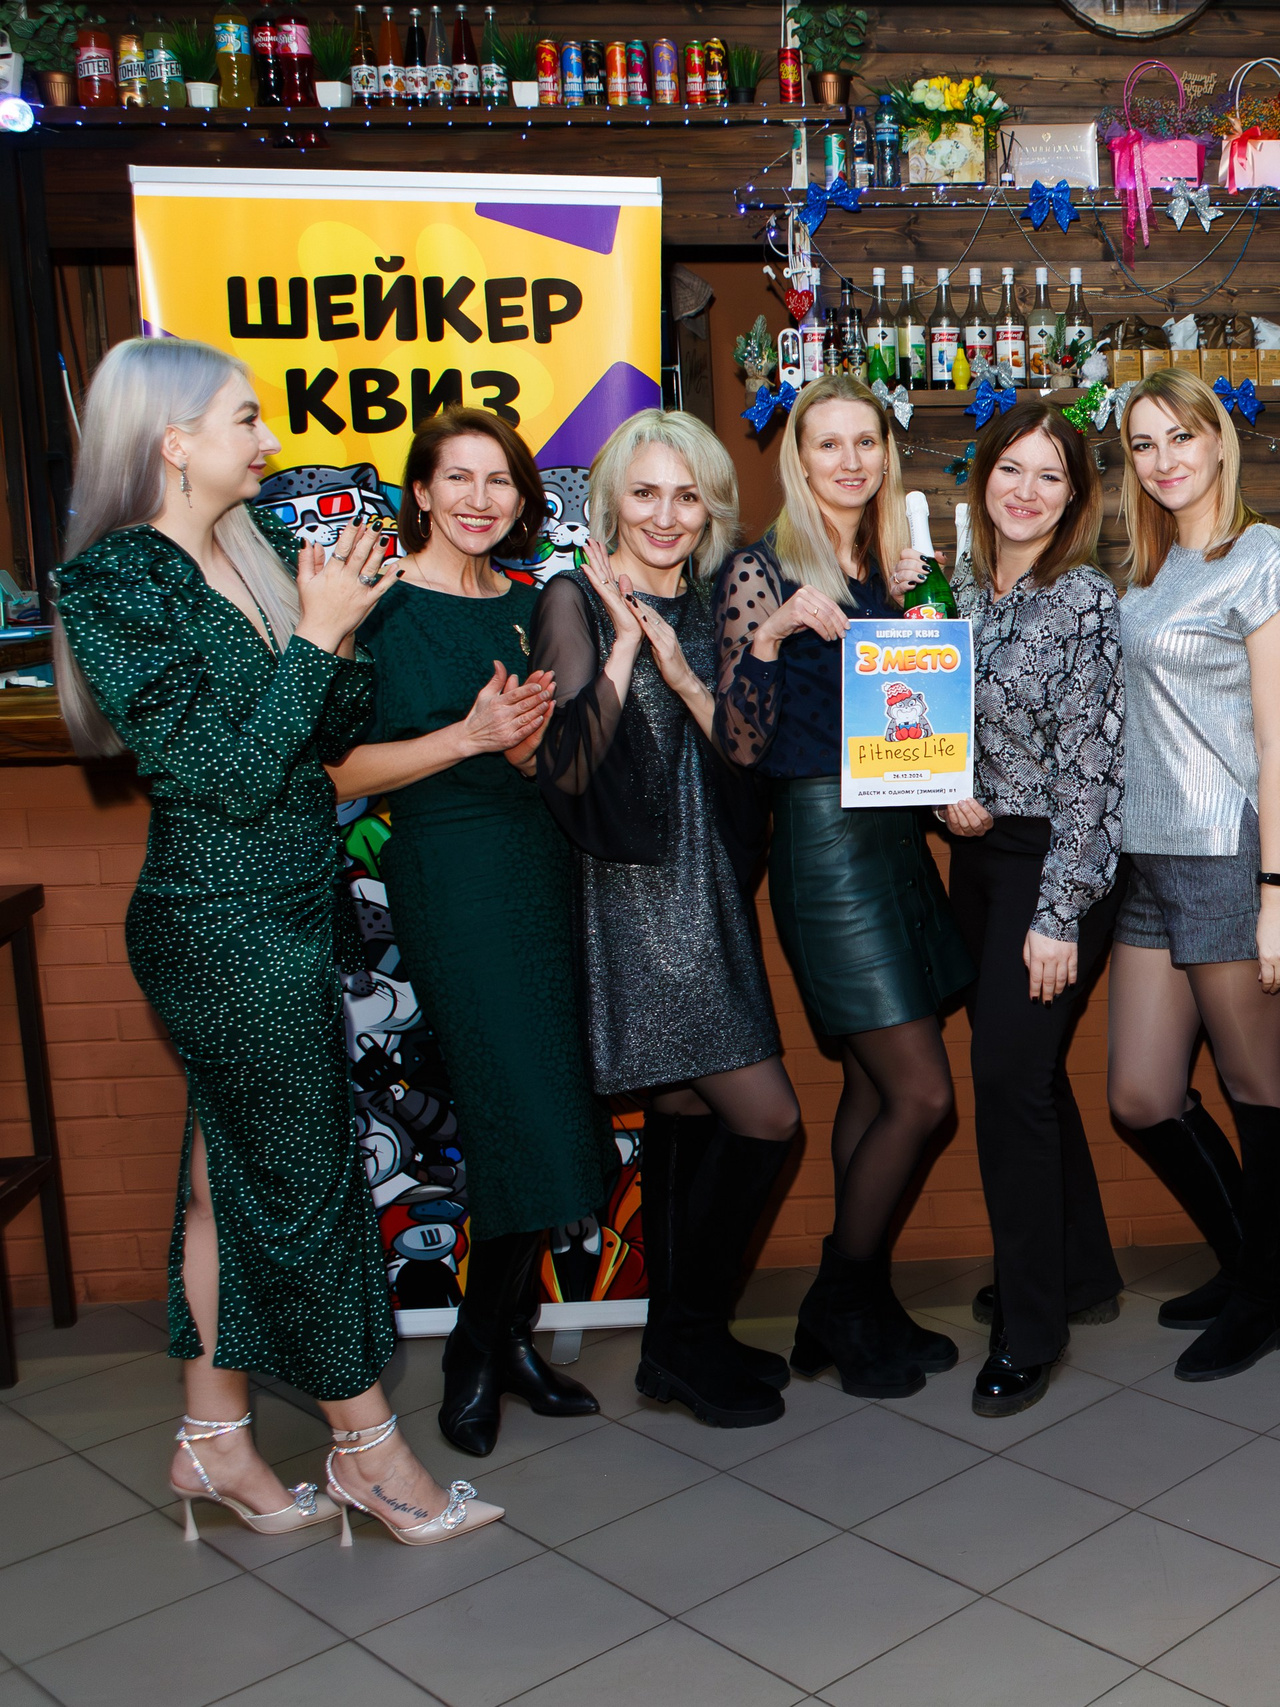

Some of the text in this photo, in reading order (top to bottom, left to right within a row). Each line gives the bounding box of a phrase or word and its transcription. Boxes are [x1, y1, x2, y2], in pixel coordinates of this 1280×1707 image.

[78, 60, 109, 76] BITTER
[564, 83, 582, 91] GORILL
[608, 83, 627, 91] GORILL
[227, 255, 583, 344] ШЕЙКЕР
[806, 333, 825, 342] Barin
[285, 367, 520, 435] КВИЗ
[876, 628, 940, 638] ШЕЙКЕР КВИЗ
[858, 644, 959, 673] 3 МЕСТО
[924, 737, 955, 758] Life
